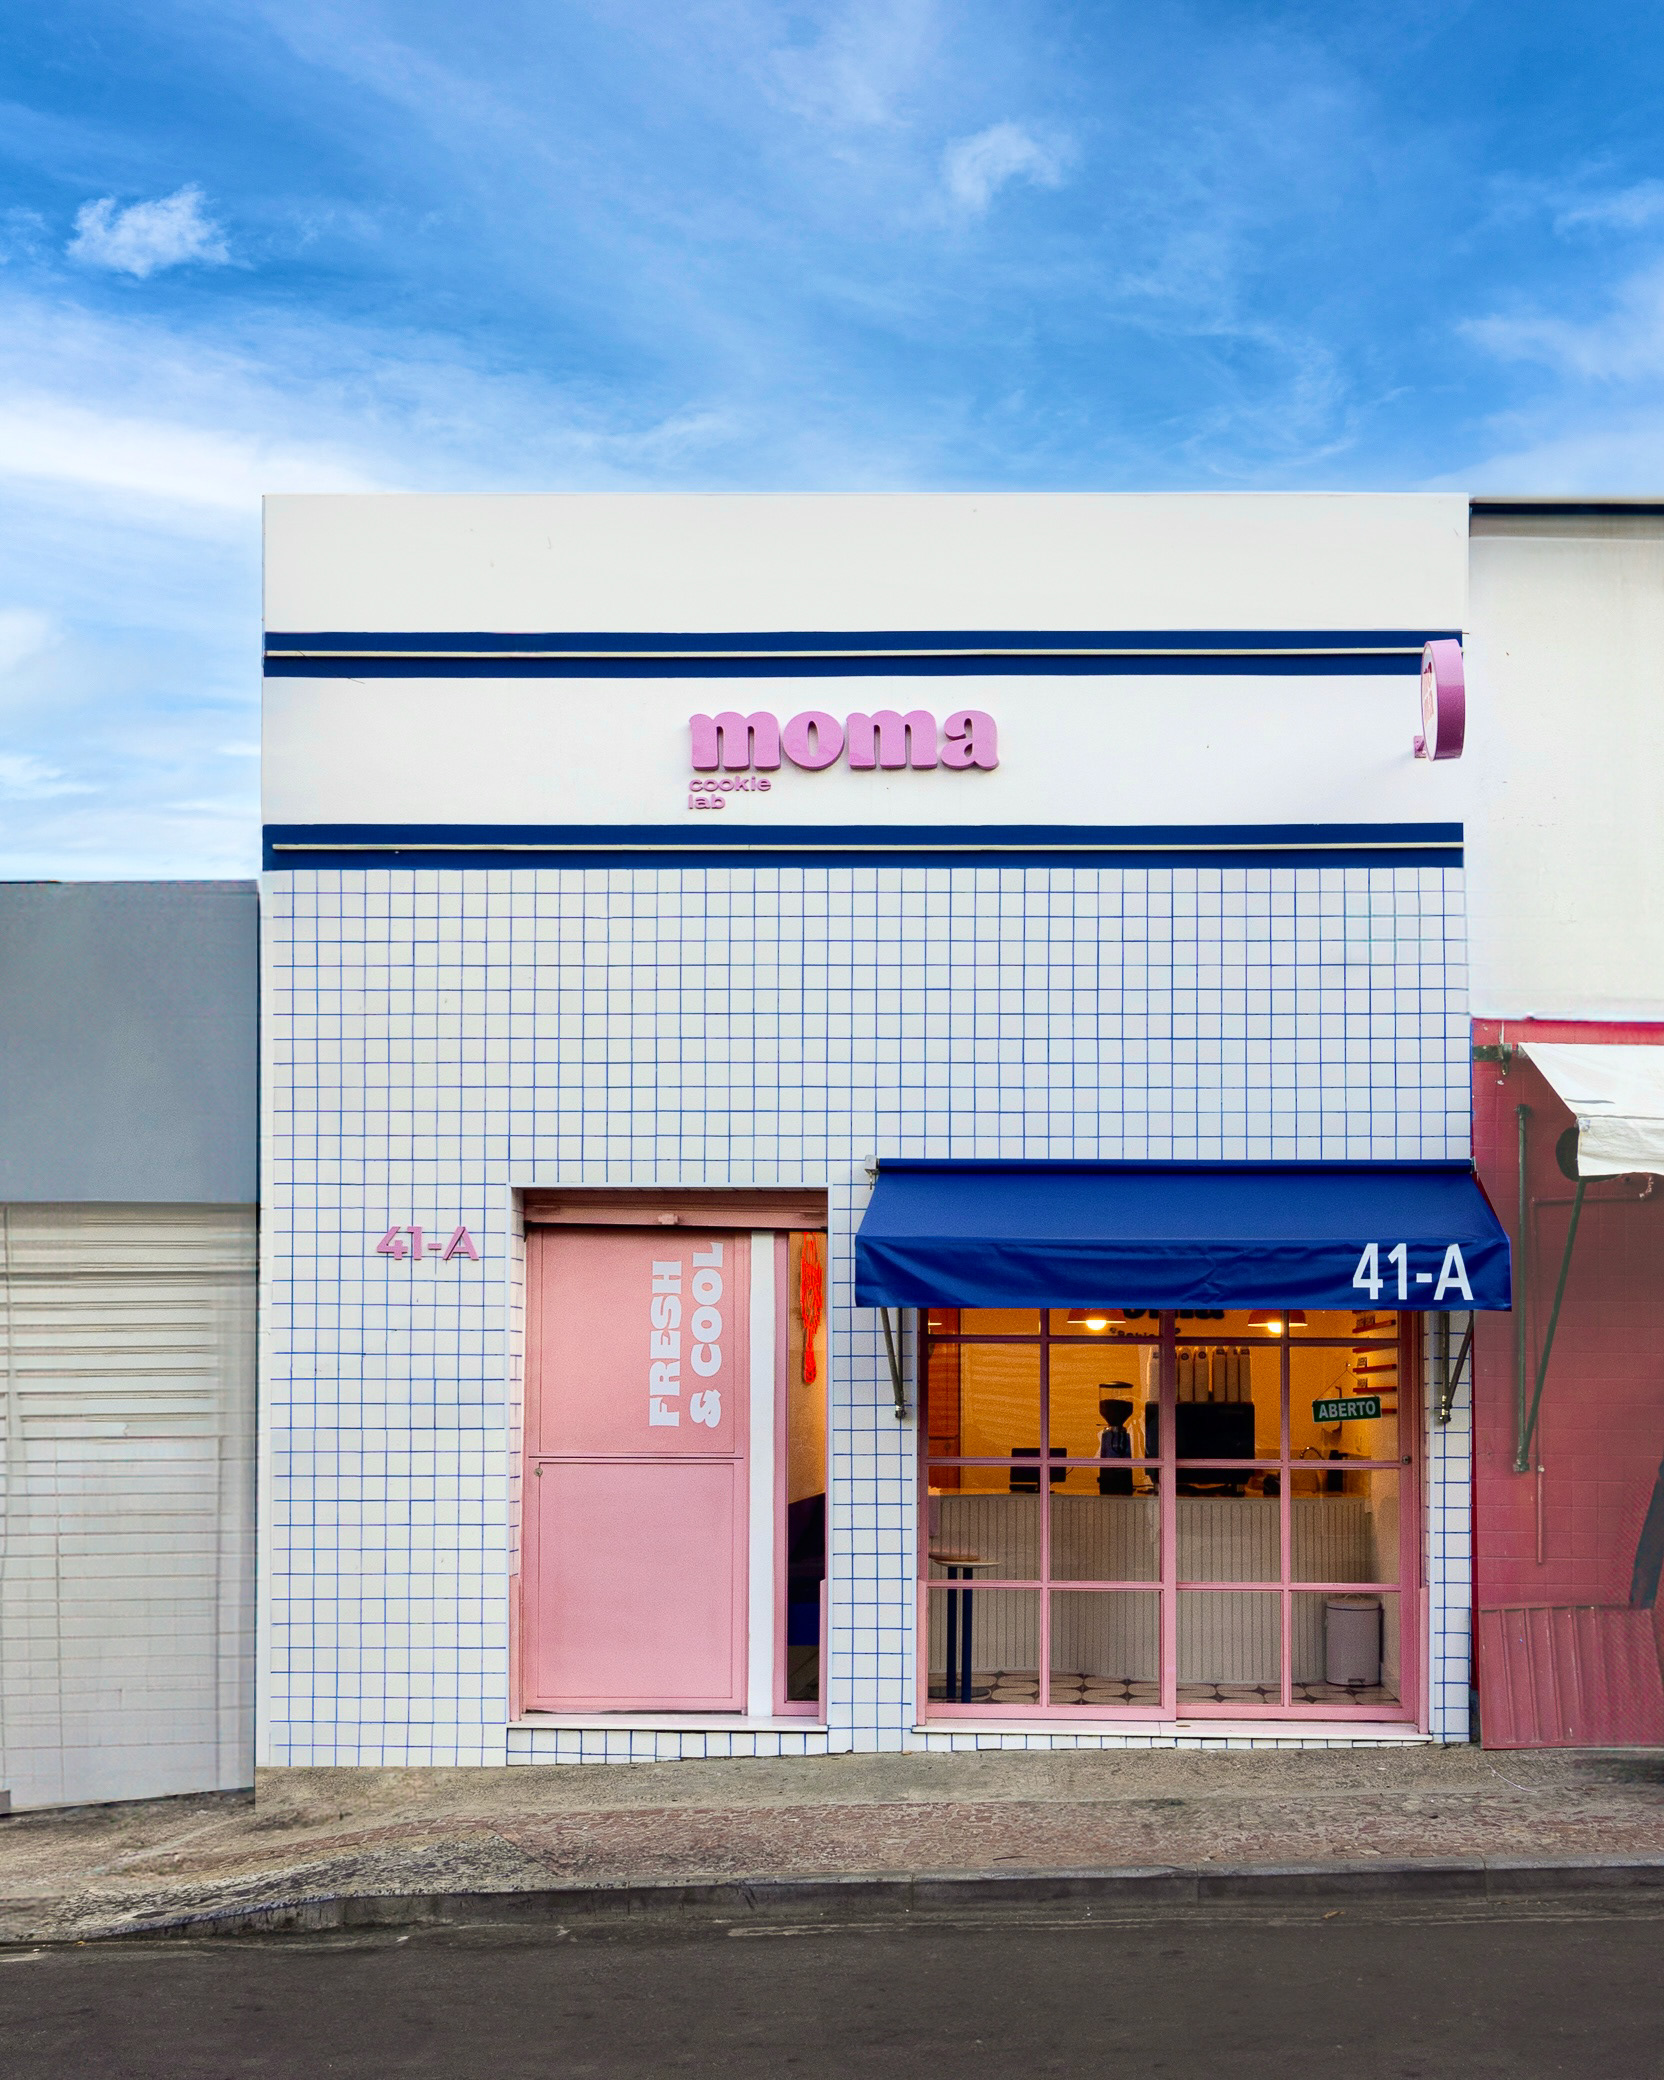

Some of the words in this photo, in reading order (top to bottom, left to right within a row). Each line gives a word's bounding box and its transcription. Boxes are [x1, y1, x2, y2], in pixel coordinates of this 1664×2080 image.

[689, 710, 1000, 771] moma
[688, 794, 726, 810] lab
[689, 776, 771, 792] cookie
[376, 1226, 480, 1261] 41-A
[1352, 1242, 1474, 1301] 41-A
[690, 1241, 724, 1377] COOL
[649, 1260, 682, 1427] FRESH
[689, 1388, 722, 1429] &
[1318, 1400, 1376, 1419] ABERTO
